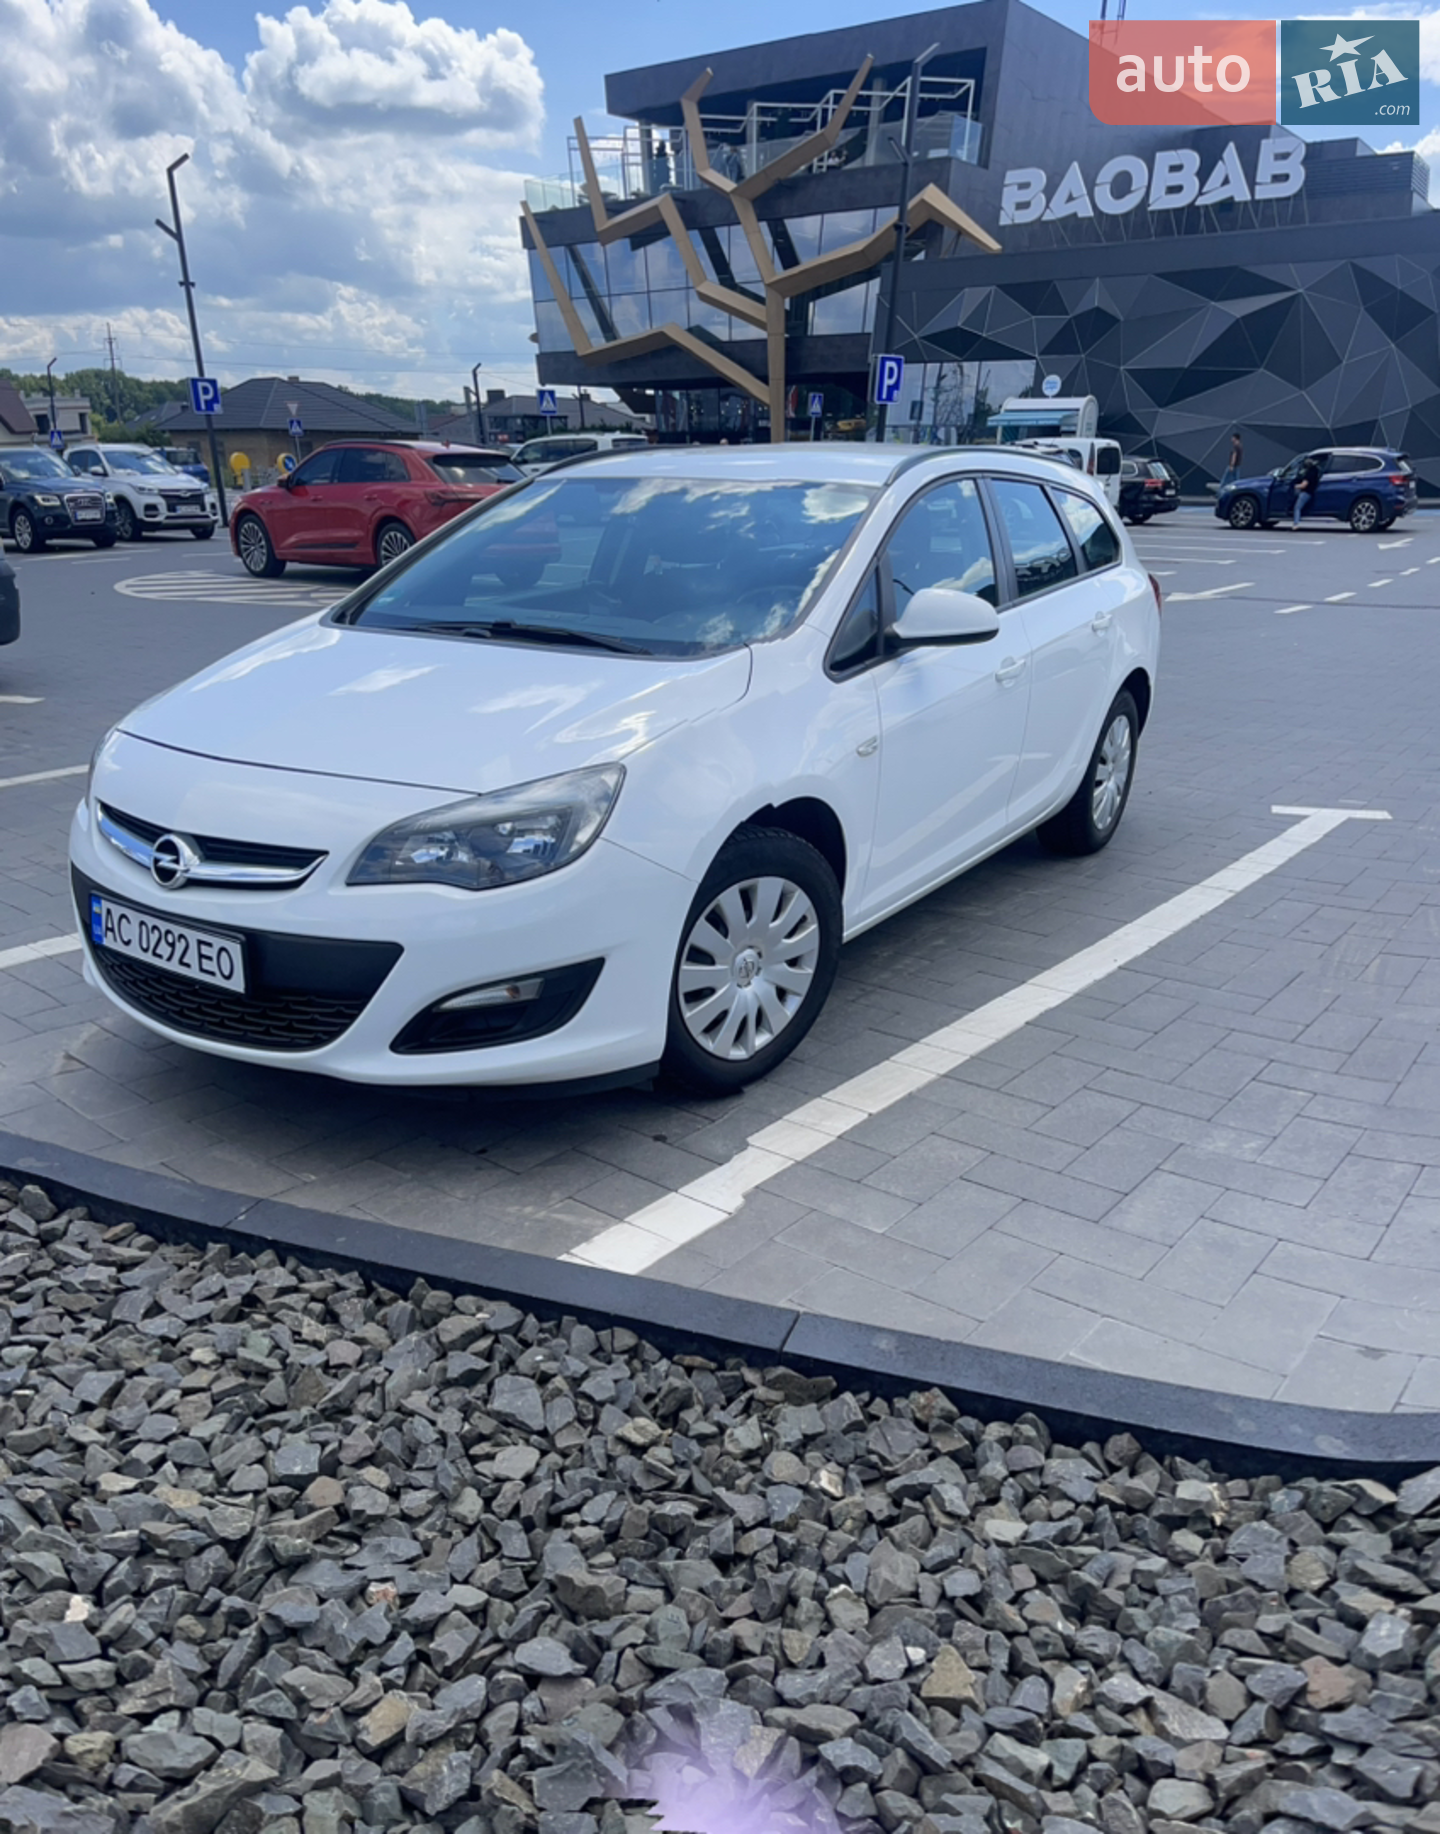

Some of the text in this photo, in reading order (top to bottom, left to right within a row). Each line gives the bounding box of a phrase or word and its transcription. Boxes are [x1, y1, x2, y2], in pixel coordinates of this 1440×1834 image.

[999, 137, 1306, 226] BAOBAB
[197, 381, 213, 410] P
[882, 361, 899, 400] P
[104, 907, 235, 981] AC 0292 EO
